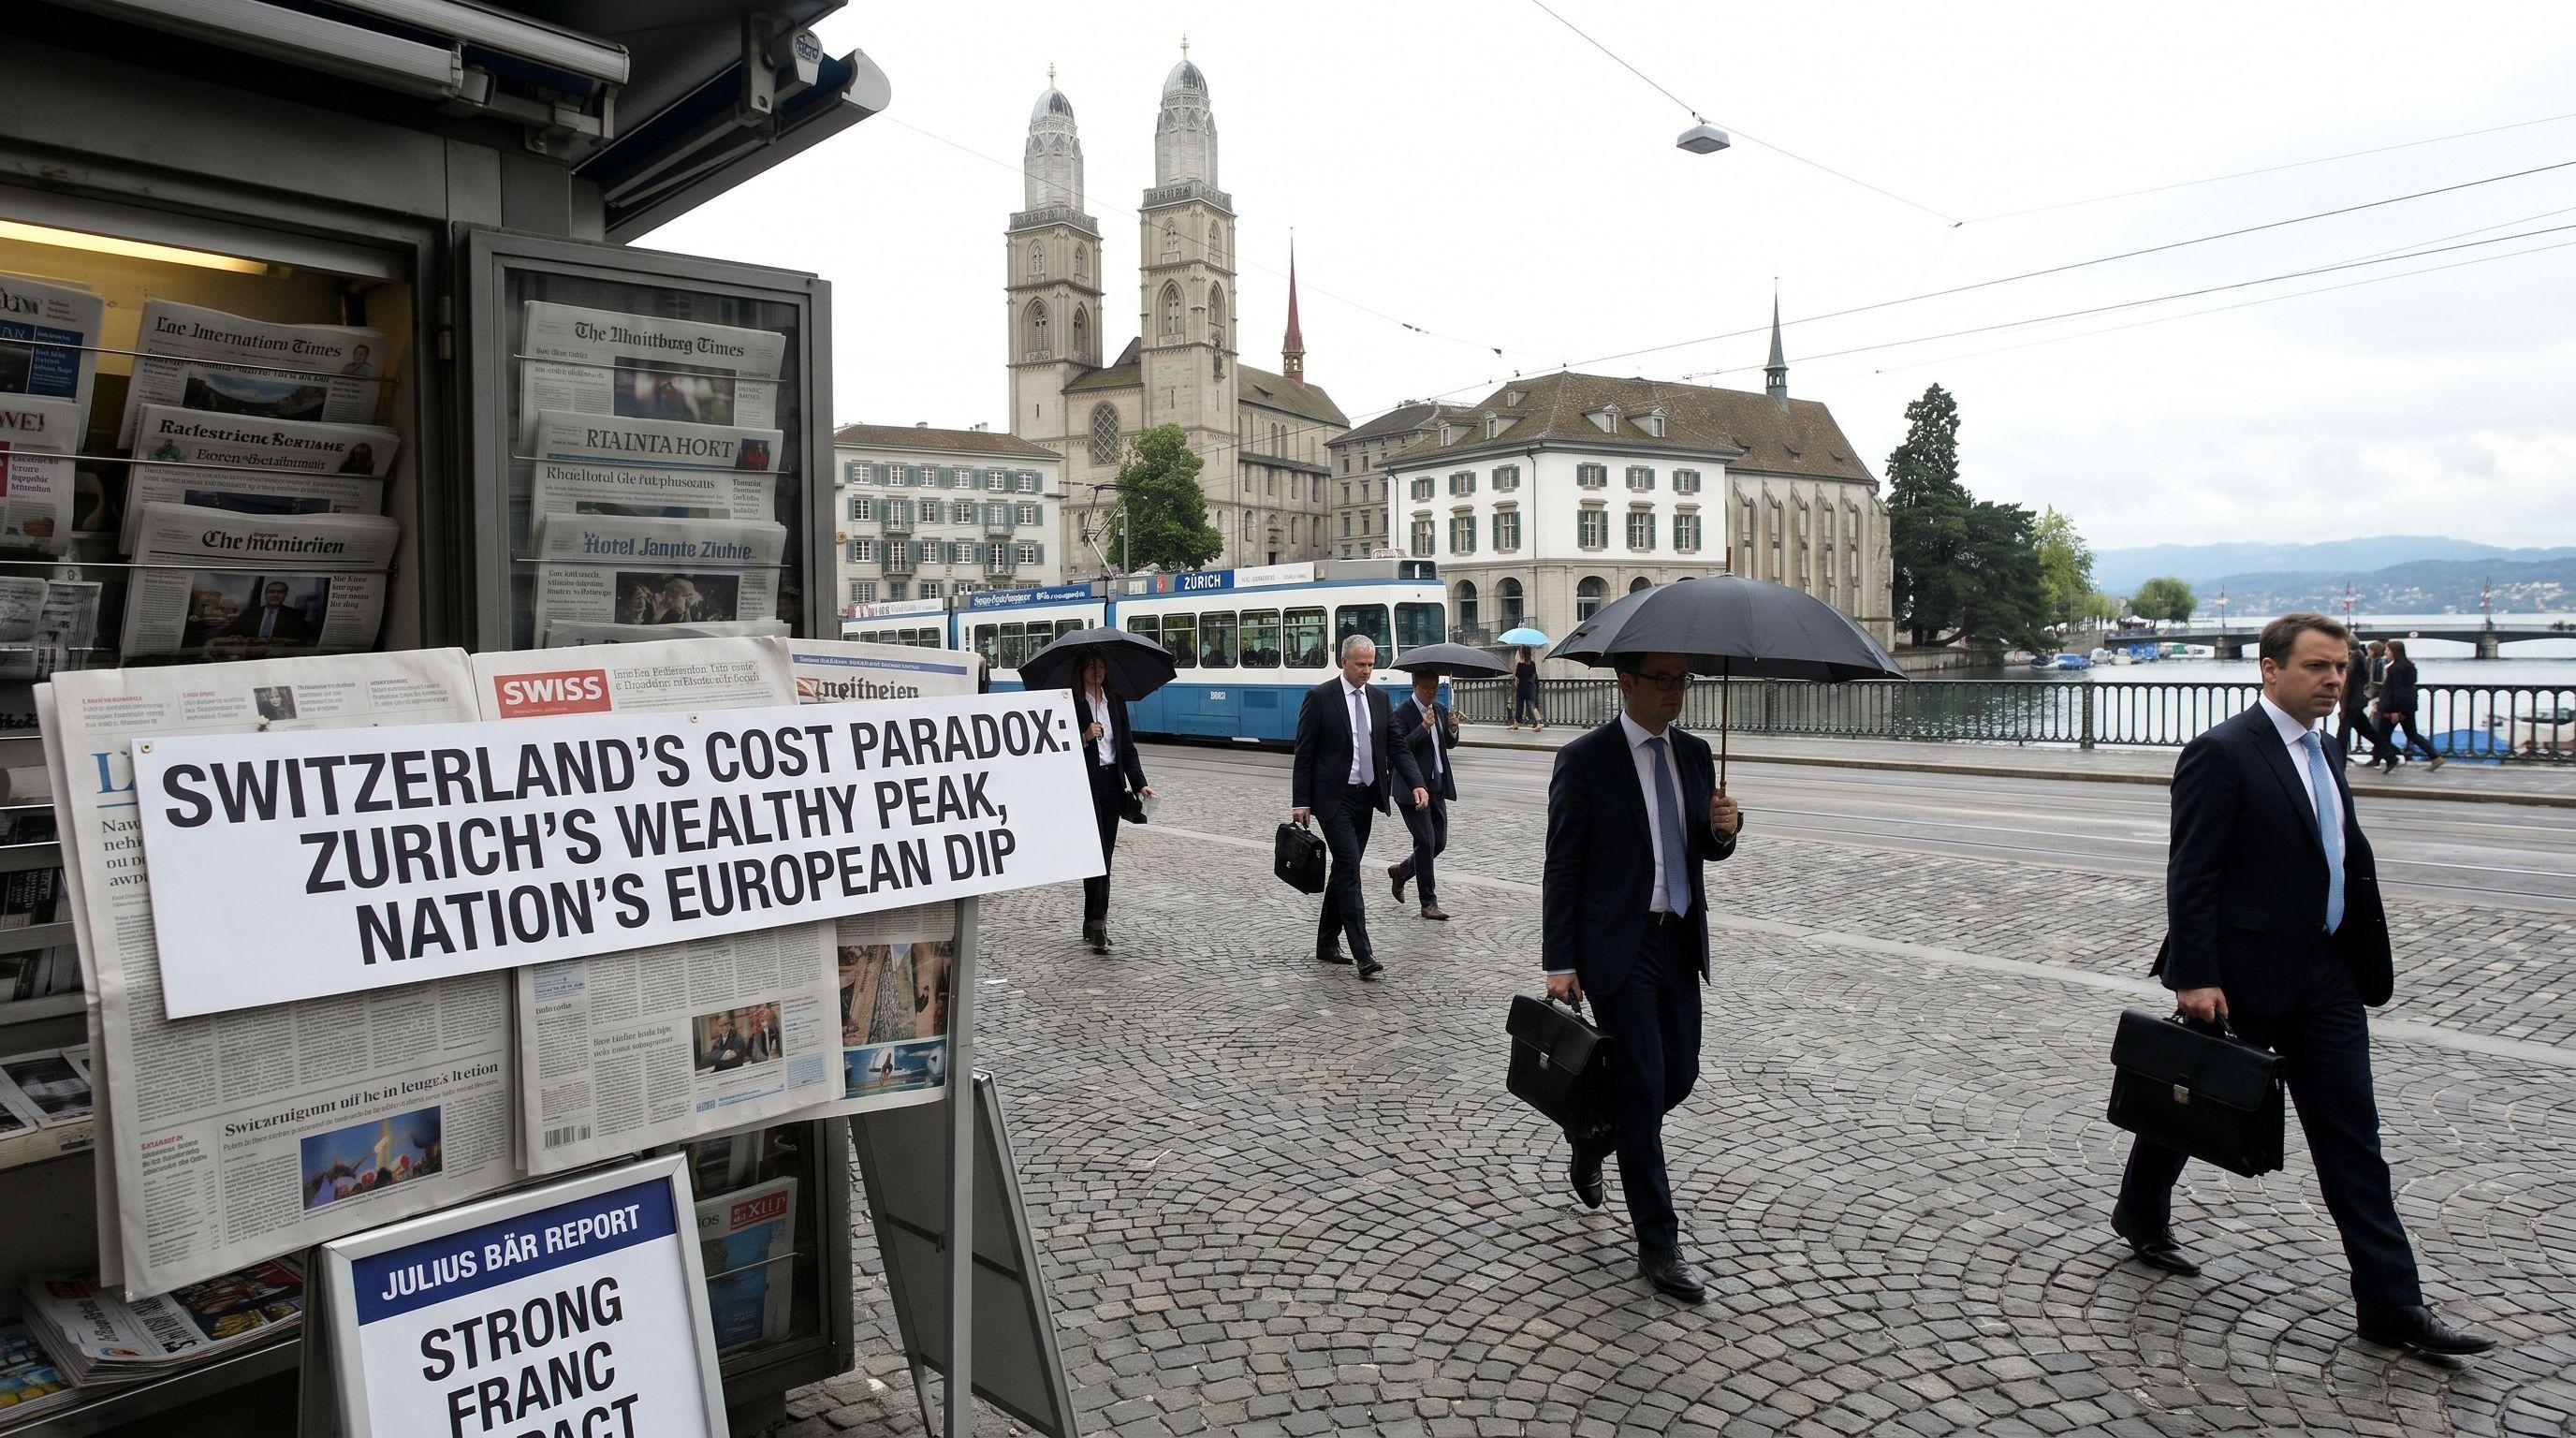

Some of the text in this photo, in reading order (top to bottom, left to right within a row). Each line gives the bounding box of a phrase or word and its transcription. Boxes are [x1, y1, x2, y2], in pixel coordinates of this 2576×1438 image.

[291, 338, 343, 358] Times
[574, 321, 607, 344] The
[696, 336, 745, 358] Times
[1184, 573, 1222, 590] ZÜRICH
[503, 676, 603, 706] SWISS
[161, 709, 1072, 829] SWITZERLAND'S COST PARADOX:
[300, 770, 1008, 895] ZURICH'S WEALTHY PEAK,
[355, 828, 1017, 966] NATION'S EUROPEAN DIP
[381, 1203, 641, 1301] JULIUS BÄR REPORT
[420, 1276, 623, 1382] STRONG
[446, 1341, 615, 1438] FRANC
[516, 1393, 639, 1438] CT
